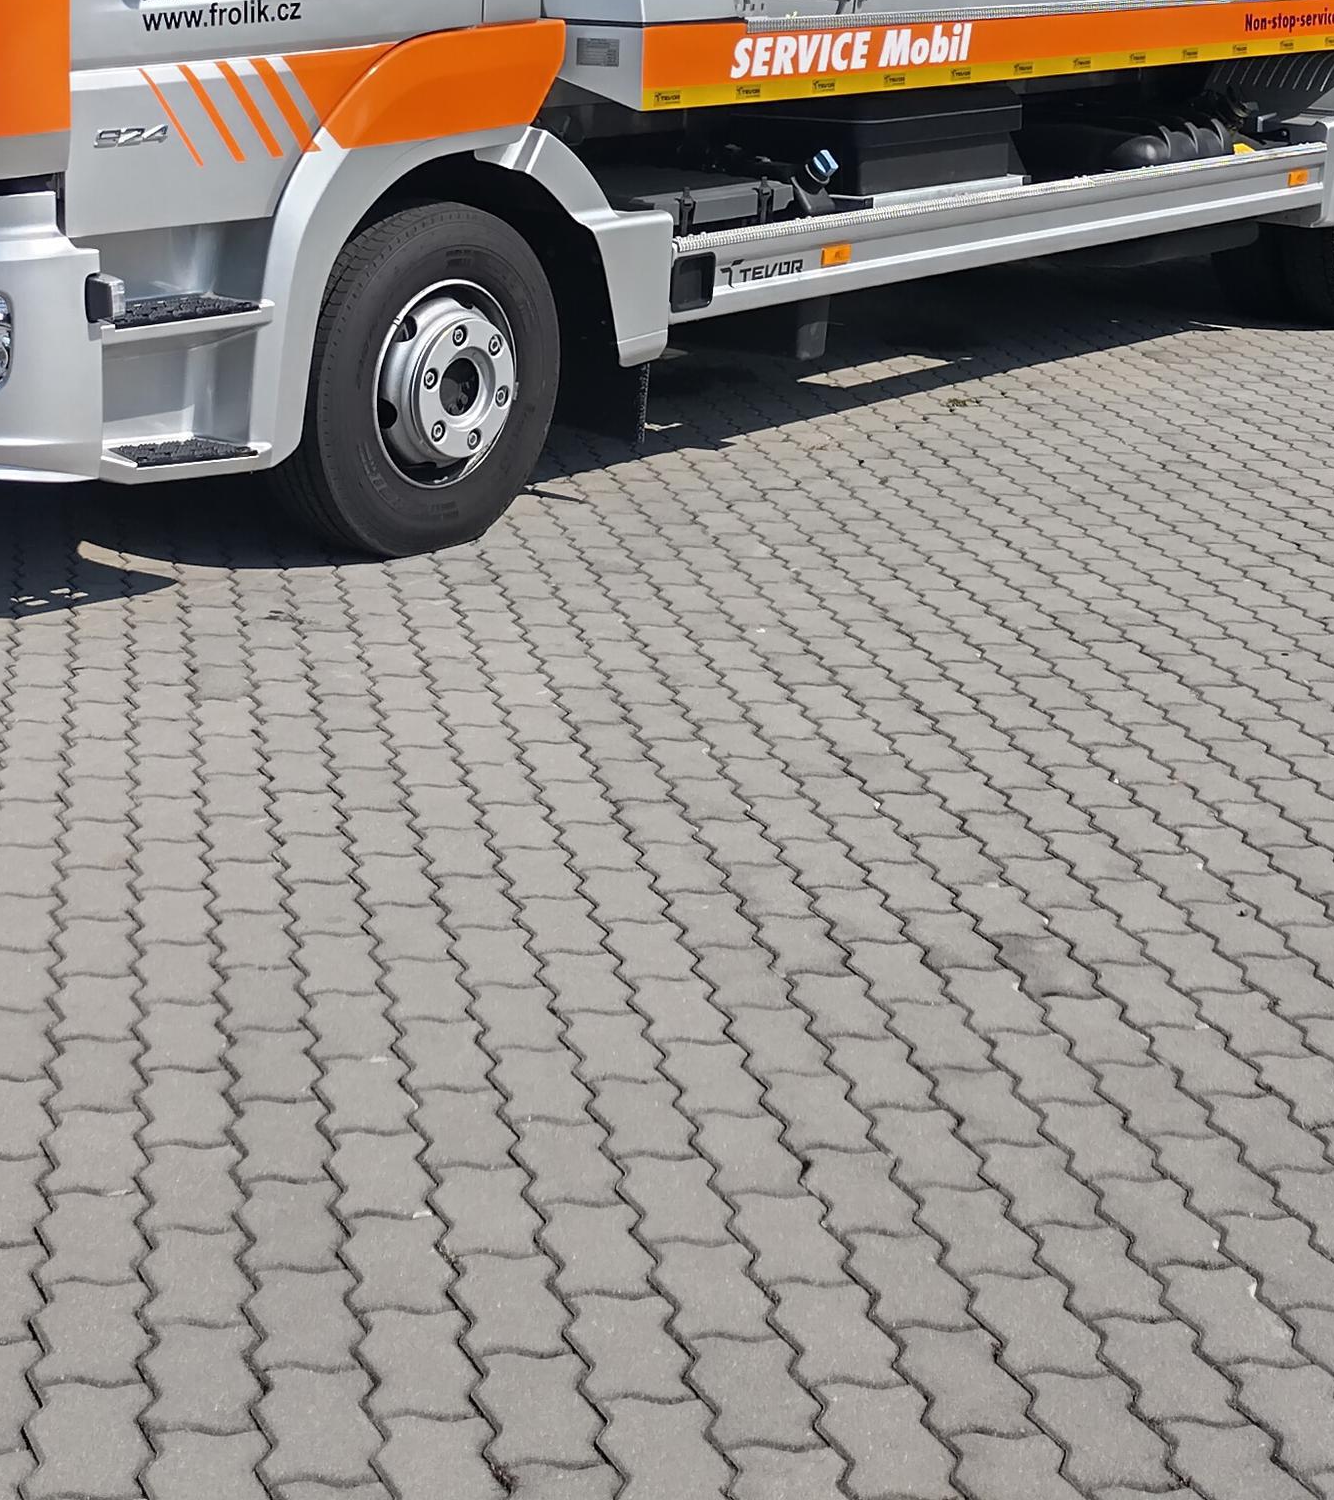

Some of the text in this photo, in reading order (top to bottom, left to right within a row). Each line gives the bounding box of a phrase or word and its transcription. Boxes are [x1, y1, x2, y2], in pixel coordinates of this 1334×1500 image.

[142, 0, 302, 32] www.frolik.cz
[730, 23, 973, 79] SERVICE Mobil
[739, 259, 803, 283] TEVOR
